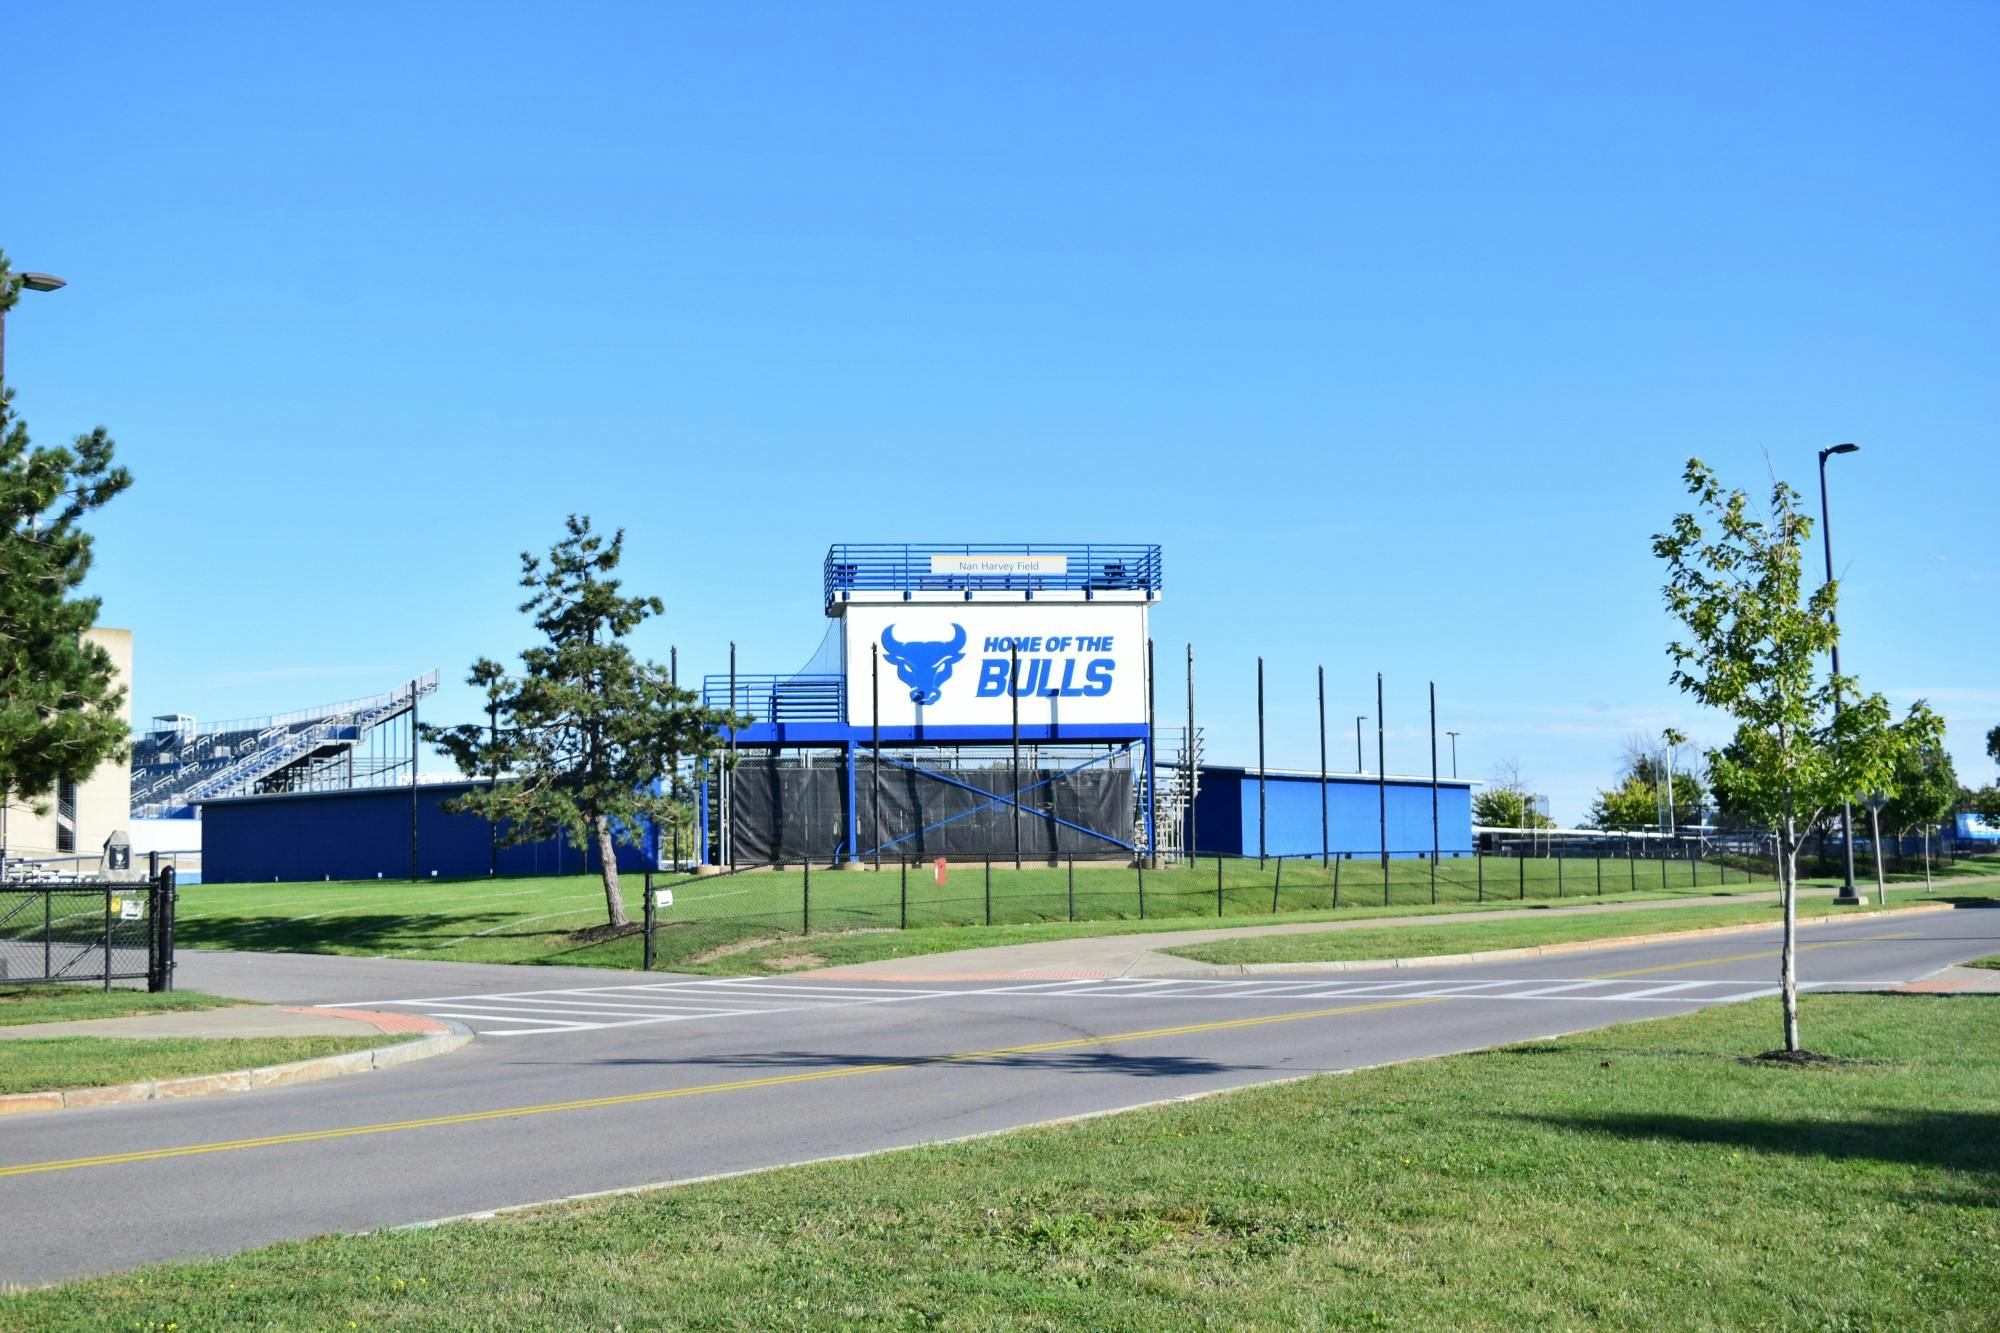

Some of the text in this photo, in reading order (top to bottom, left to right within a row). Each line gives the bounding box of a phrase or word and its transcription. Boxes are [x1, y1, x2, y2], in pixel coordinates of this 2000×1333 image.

[959, 561, 1040, 574] Nan Harvey Field
[983, 636, 1115, 653] HOME OF THE
[975, 658, 1116, 698] BULLS
